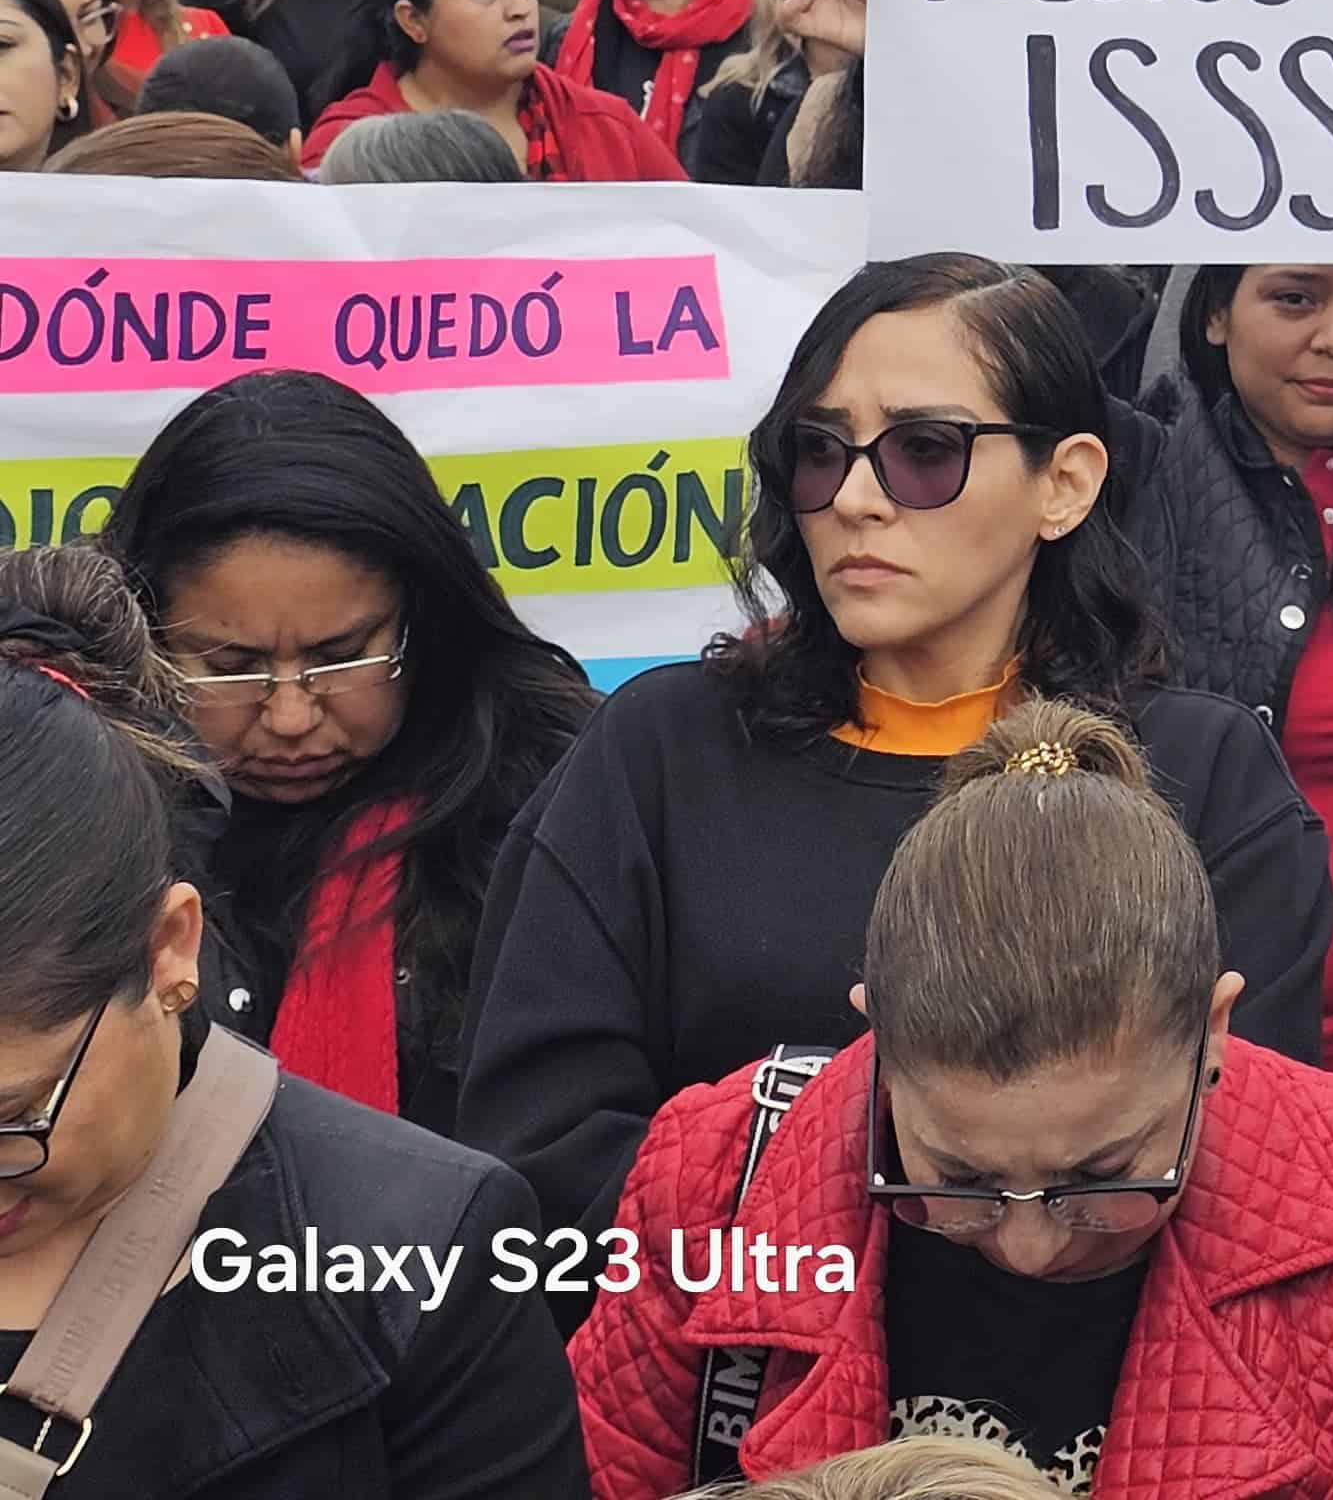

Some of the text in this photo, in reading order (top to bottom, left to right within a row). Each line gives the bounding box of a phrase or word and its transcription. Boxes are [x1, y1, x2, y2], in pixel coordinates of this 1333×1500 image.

[0, 267, 719, 370] DÓNDE QUEDÓ LA
